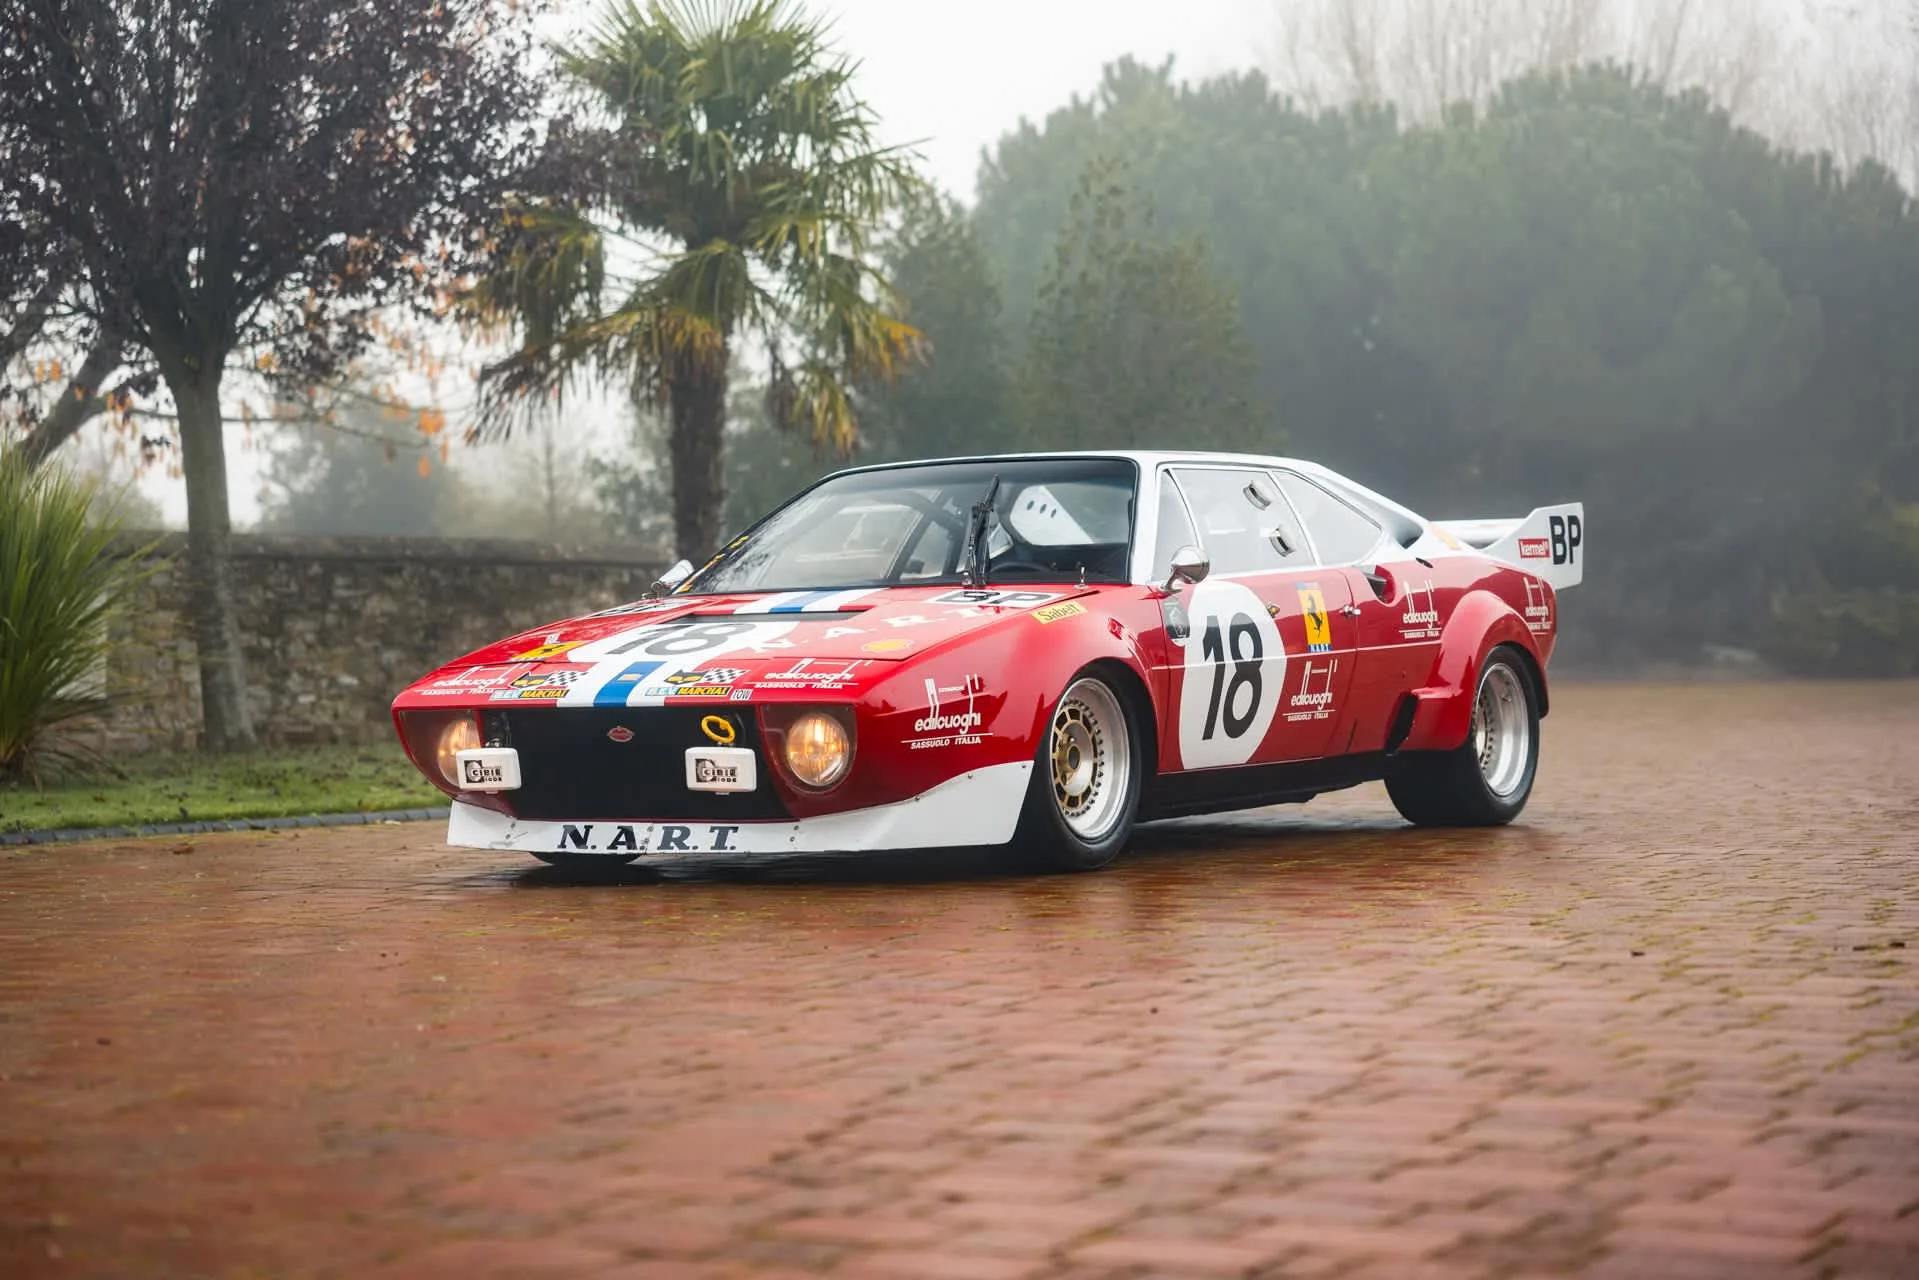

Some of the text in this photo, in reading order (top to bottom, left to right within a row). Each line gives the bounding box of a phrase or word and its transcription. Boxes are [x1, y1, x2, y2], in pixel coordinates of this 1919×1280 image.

[1549, 515, 1581, 565] BP
[936, 590, 1051, 605] BP
[604, 624, 756, 655] 18
[1202, 612, 1264, 740] 18
[733, 690, 751, 700] TOW
[911, 737, 981, 749] SASSUOLO ITALIA
